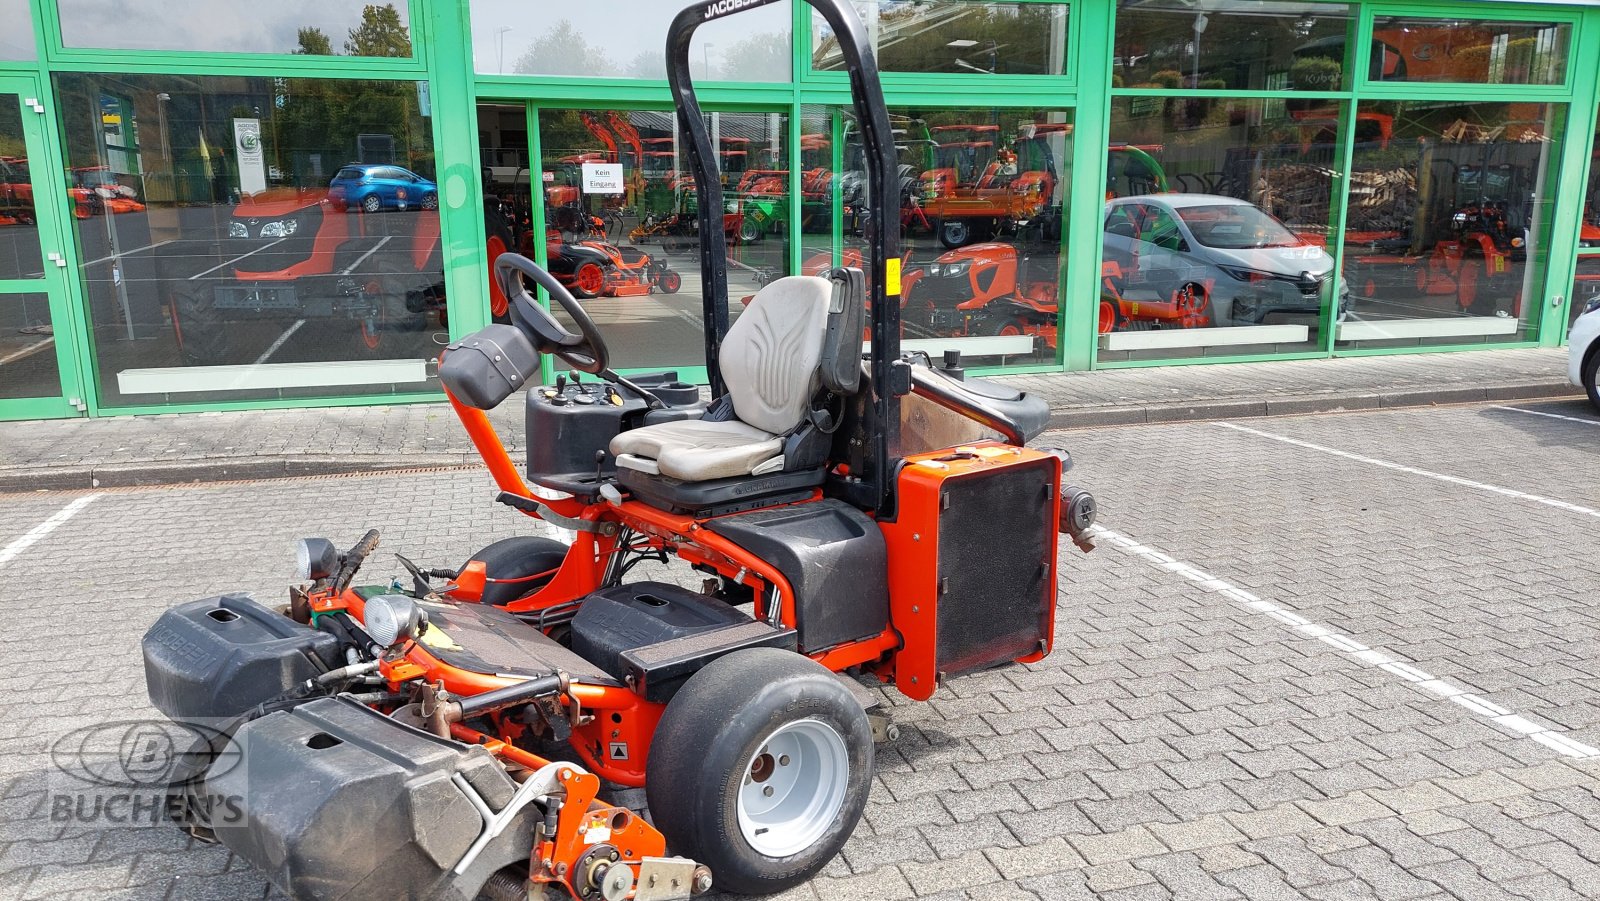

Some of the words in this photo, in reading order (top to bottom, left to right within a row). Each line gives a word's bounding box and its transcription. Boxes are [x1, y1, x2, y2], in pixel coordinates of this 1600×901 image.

[704, 0, 760, 18] JACOB
[1305, 71, 1342, 84] Kubot
[590, 180, 617, 188] Eingang
